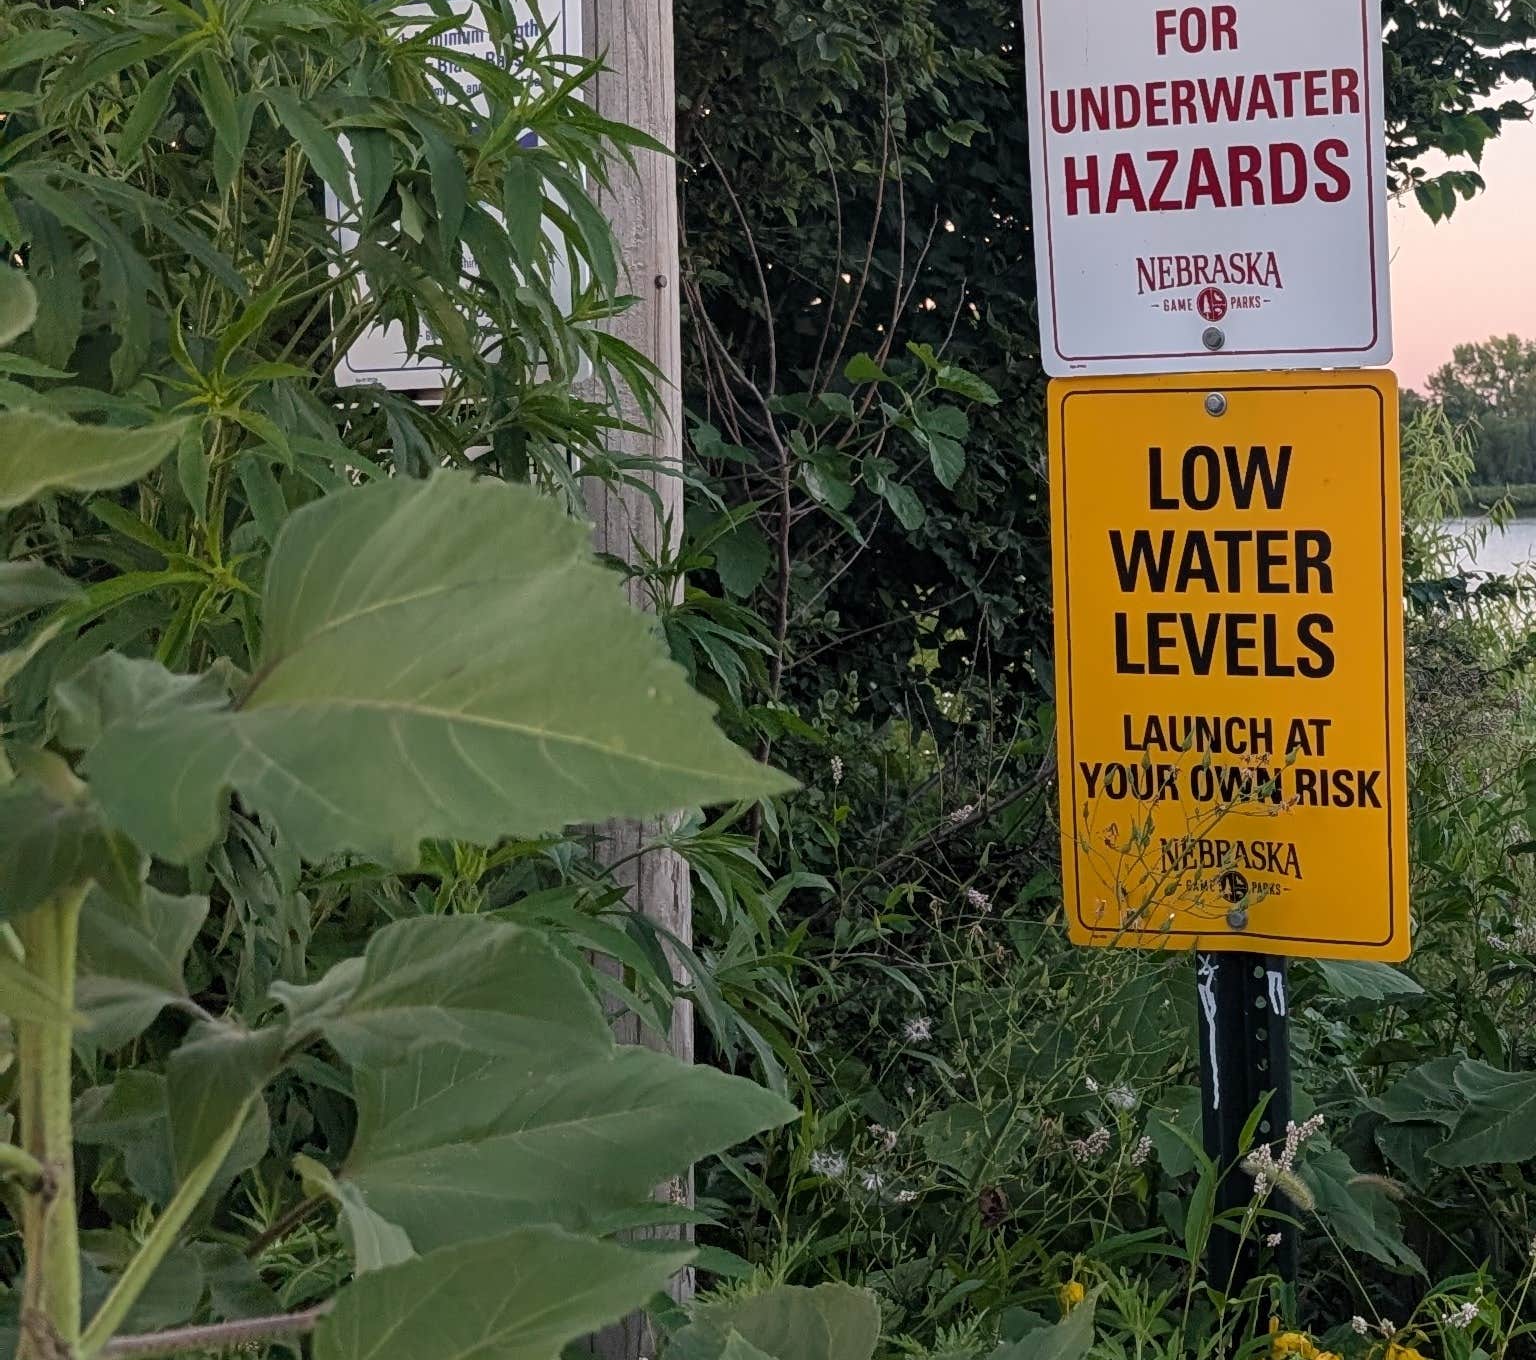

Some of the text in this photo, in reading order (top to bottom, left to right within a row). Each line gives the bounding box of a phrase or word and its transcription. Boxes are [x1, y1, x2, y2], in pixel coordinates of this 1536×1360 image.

[1155, 5, 1238, 56] FOR
[1050, 68, 1360, 134] UNDERWATER
[1063, 138, 1351, 217] HAZARDS
[1135, 251, 1284, 295] NEBRASKA
[1163, 295, 1261, 312] GAME PARKS
[1148, 445, 1293, 511] LOW
[1108, 529, 1334, 594] WATER
[1114, 612, 1335, 679] LEVELS
[1123, 714, 1332, 757] LAUNCH AT
[1079, 761, 1382, 809] YOUR OWN RISK
